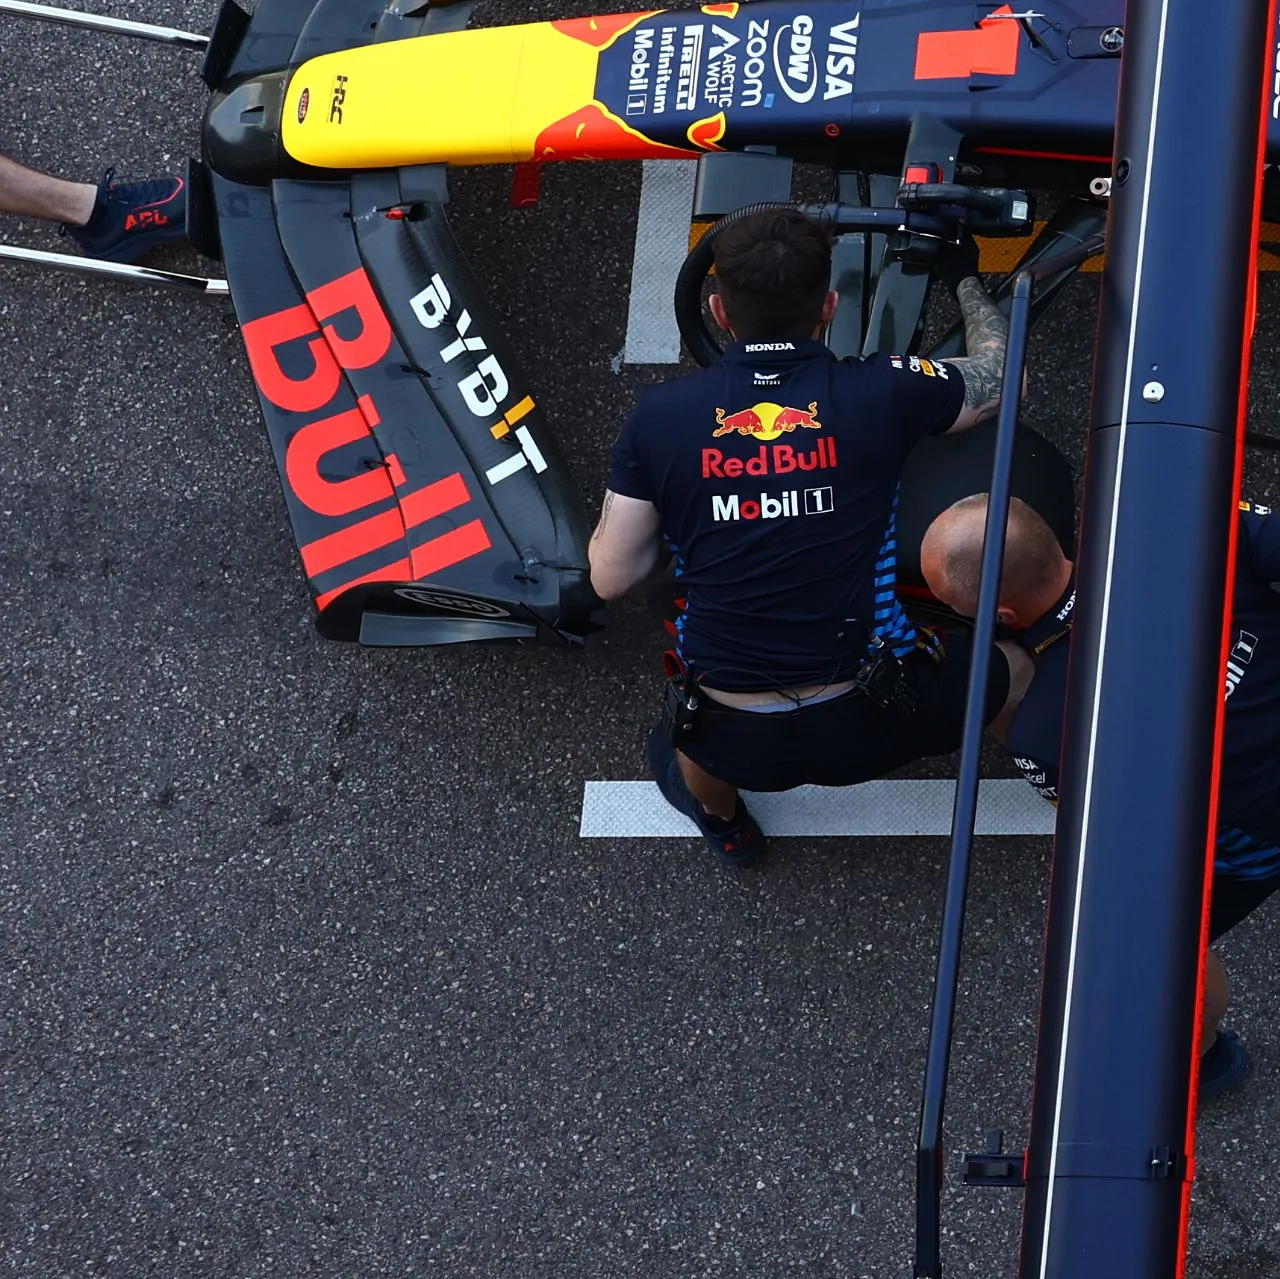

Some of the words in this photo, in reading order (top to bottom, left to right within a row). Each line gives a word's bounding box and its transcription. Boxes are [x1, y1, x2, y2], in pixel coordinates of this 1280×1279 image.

[629, 28, 655, 92] Mobil
[652, 26, 677, 115] infinitum
[676, 24, 704, 111] PIRELLI
[718, 53, 736, 108] ARCTIC
[741, 20, 769, 107] zoom
[784, 14, 814, 83] CDW
[823, 11, 860, 101] VISA
[330, 75, 348, 124] HRC
[704, 63, 721, 104] WOLF
[409, 273, 548, 485] BYBIT
[745, 341, 796, 353] HONDA
[242, 267, 491, 612] Bull
[702, 446, 768, 478] Red
[773, 437, 838, 474] Bull
[712, 490, 799, 521] Mobil
[1056, 588, 1077, 621] HON
